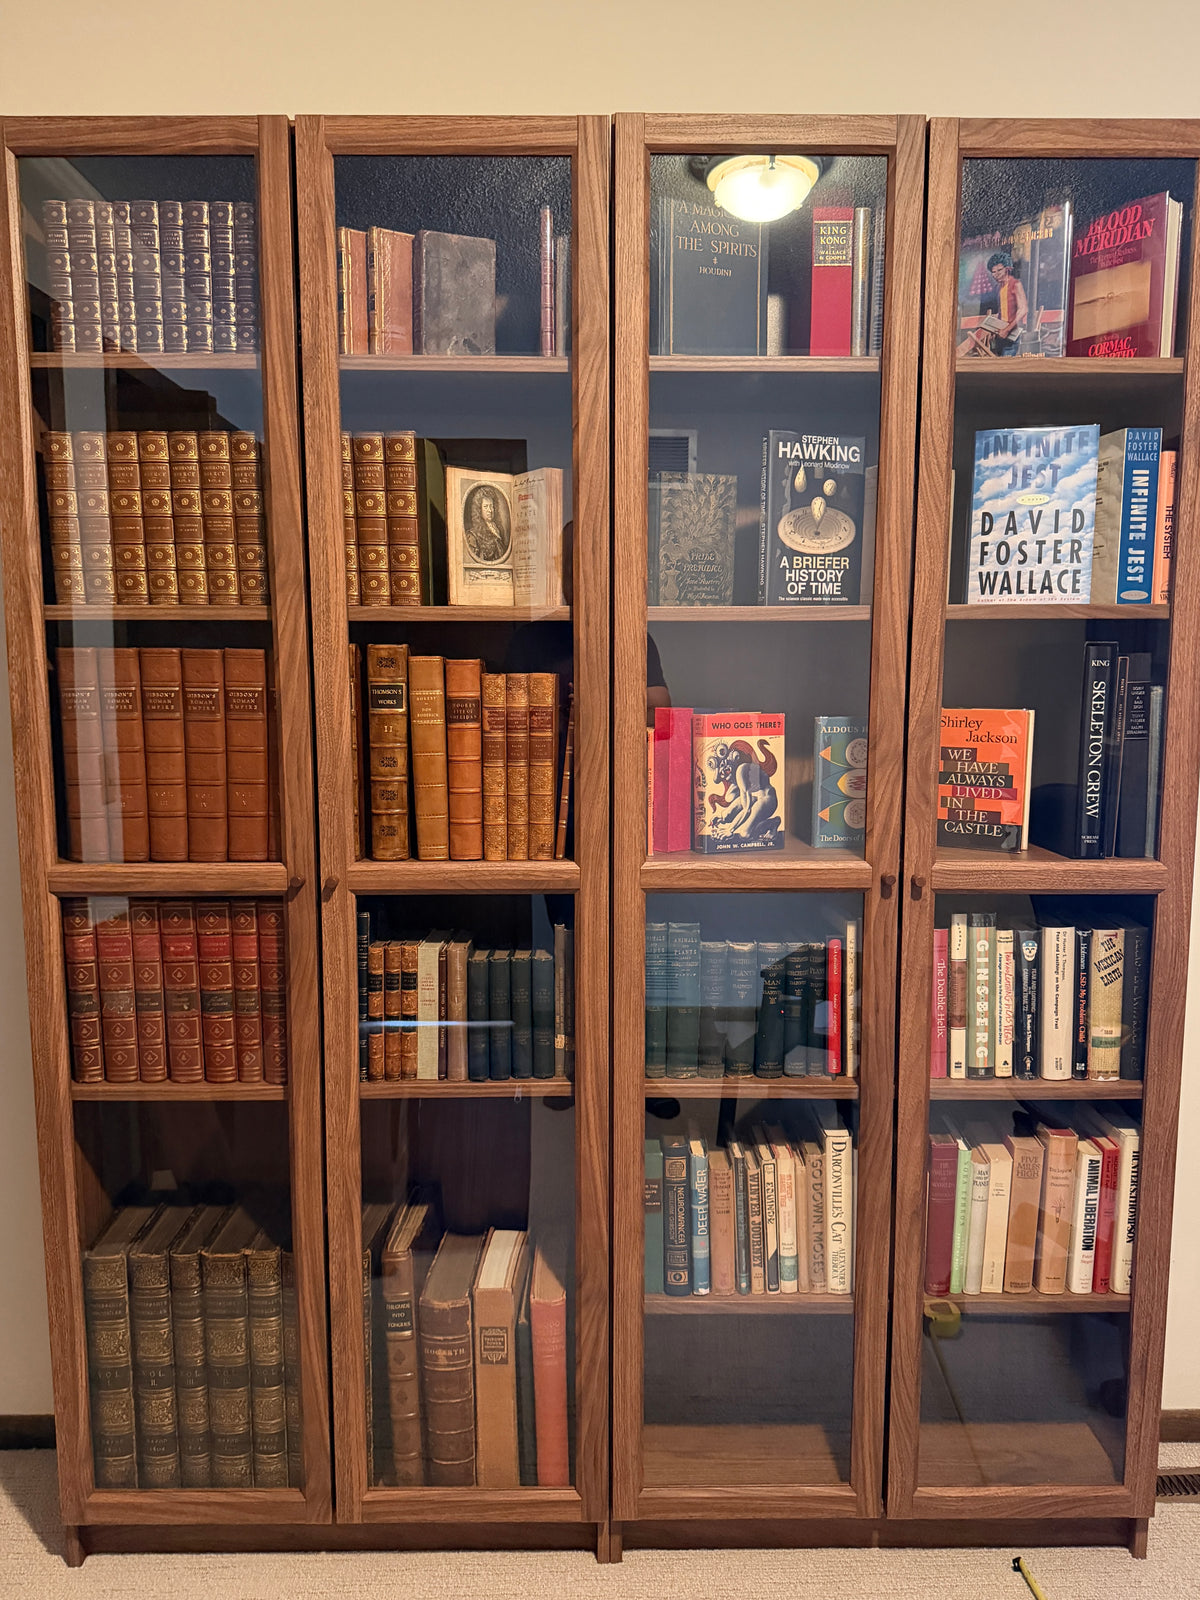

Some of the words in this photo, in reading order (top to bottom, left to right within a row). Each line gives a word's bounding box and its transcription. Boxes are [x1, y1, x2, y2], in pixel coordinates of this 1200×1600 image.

[690, 220, 740, 238] AMONG
[819, 226, 848, 235] KING
[1087, 204, 1143, 238] BLOOD
[675, 235, 704, 252] THE
[710, 239, 758, 258] SPIRITS
[819, 236, 848, 245] KONG
[1074, 217, 1156, 259] MERIDIAN
[699, 266, 732, 278] HOUDINI
[1088, 336, 1132, 358] CORMAC
[801, 434, 840, 445] STEPHEN
[983, 430, 1090, 460] INFINITE
[1128, 431, 1159, 440] DAVID
[778, 441, 861, 463] HAWKING
[1127, 442, 1158, 451] FOSTER
[1127, 452, 1158, 461] WALLACE
[1007, 463, 1061, 490] JEST
[1129, 469, 1150, 540] INFINITE
[1165, 504, 1174, 523] THE
[981, 508, 1085, 536] DAVID
[979, 539, 1083, 566] FOSTER
[1163, 525, 1173, 560] SYSTEM
[780, 555, 789, 569] A
[793, 556, 850, 570] BRIEFER
[1126, 548, 1145, 583] JEST
[785, 569, 844, 582] HISTORY
[978, 569, 1082, 595] WALLACE
[787, 582, 807, 595] OF
[810, 582, 842, 595] TIME
[1091, 659, 1110, 668] KING
[756, 721, 781, 729] THERE?
[821, 726, 858, 734] ALDOUS
[941, 715, 983, 732] Shirley
[1089, 680, 1106, 767] SKELETON
[965, 730, 1018, 744] Jackson
[948, 748, 972, 761] WE
[957, 761, 999, 775] HAVE
[946, 773, 1006, 787] ALWAYS
[946, 797, 964, 809] IN
[956, 787, 1003, 799] LIVED
[1085, 769, 1101, 819] CREW
[955, 809, 989, 823] THE
[820, 834, 833, 842] The
[853, 834, 860, 842] of
[943, 820, 1004, 837] CASTLE
[1101, 938, 1117, 953] THE
[937, 958, 946, 976] The
[1094, 949, 1124, 973] MEXICAN
[1079, 972, 1087, 988] LSD:
[1100, 967, 1122, 987] EARTH
[937, 978, 946, 1008] Double
[976, 940, 990, 1058] GINSBERG
[1079, 989, 1085, 998] My
[936, 1012, 945, 1038] Helix
[811, 1159, 823, 1179] GO
[1016, 1169, 1039, 1177] HIGH
[1017, 1162, 1041, 1170] MILES
[1131, 1151, 1140, 1188] HUNTER
[695, 1167, 708, 1204] WATER
[831, 1141, 847, 1218] DARCONVILLE'S
[1085, 1158, 1100, 1197] ANIMAL
[749, 1172, 761, 1217] WINTER
[677, 1187, 686, 1244] NEUROMANCER
[811, 1183, 823, 1228] DOWN,
[697, 1207, 708, 1235] DEEP
[1082, 1198, 1098, 1251] LIBERATION
[1126, 1194, 1137, 1244] THOMPSON
[831, 1221, 847, 1244] CAT
[751, 1220, 763, 1268] JOURNEY
[812, 1231, 825, 1275] MOSES
[838, 1247, 846, 1286] ALEXANDER
